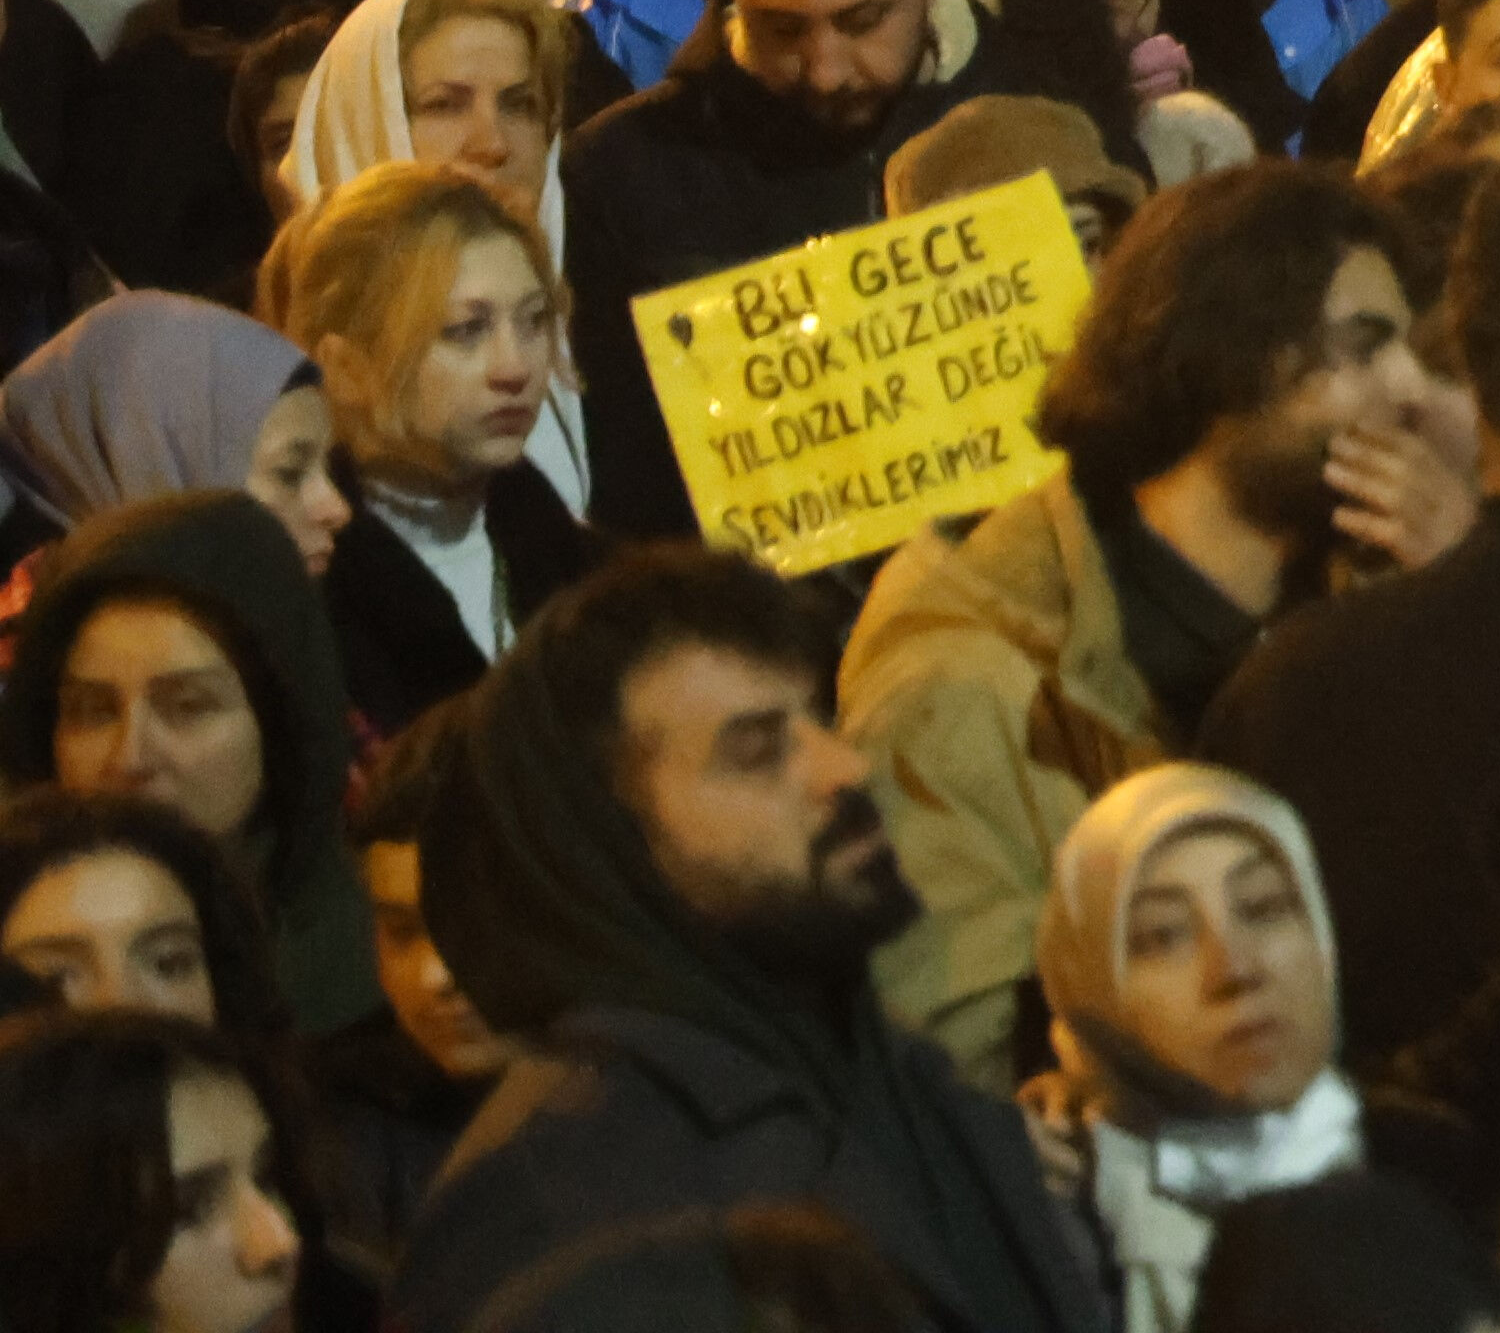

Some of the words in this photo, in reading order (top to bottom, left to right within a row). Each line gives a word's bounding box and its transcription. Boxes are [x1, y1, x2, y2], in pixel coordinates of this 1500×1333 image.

[731, 267, 817, 342] BU
[848, 216, 986, 299] GECE
[743, 259, 1040, 402] GÖKYÜZÜNDE
[708, 373, 922, 479] YILDIZLAR
[936, 323, 1052, 404] DEĞİL
[722, 425, 1009, 555] SEVDİKLERİMİZ
